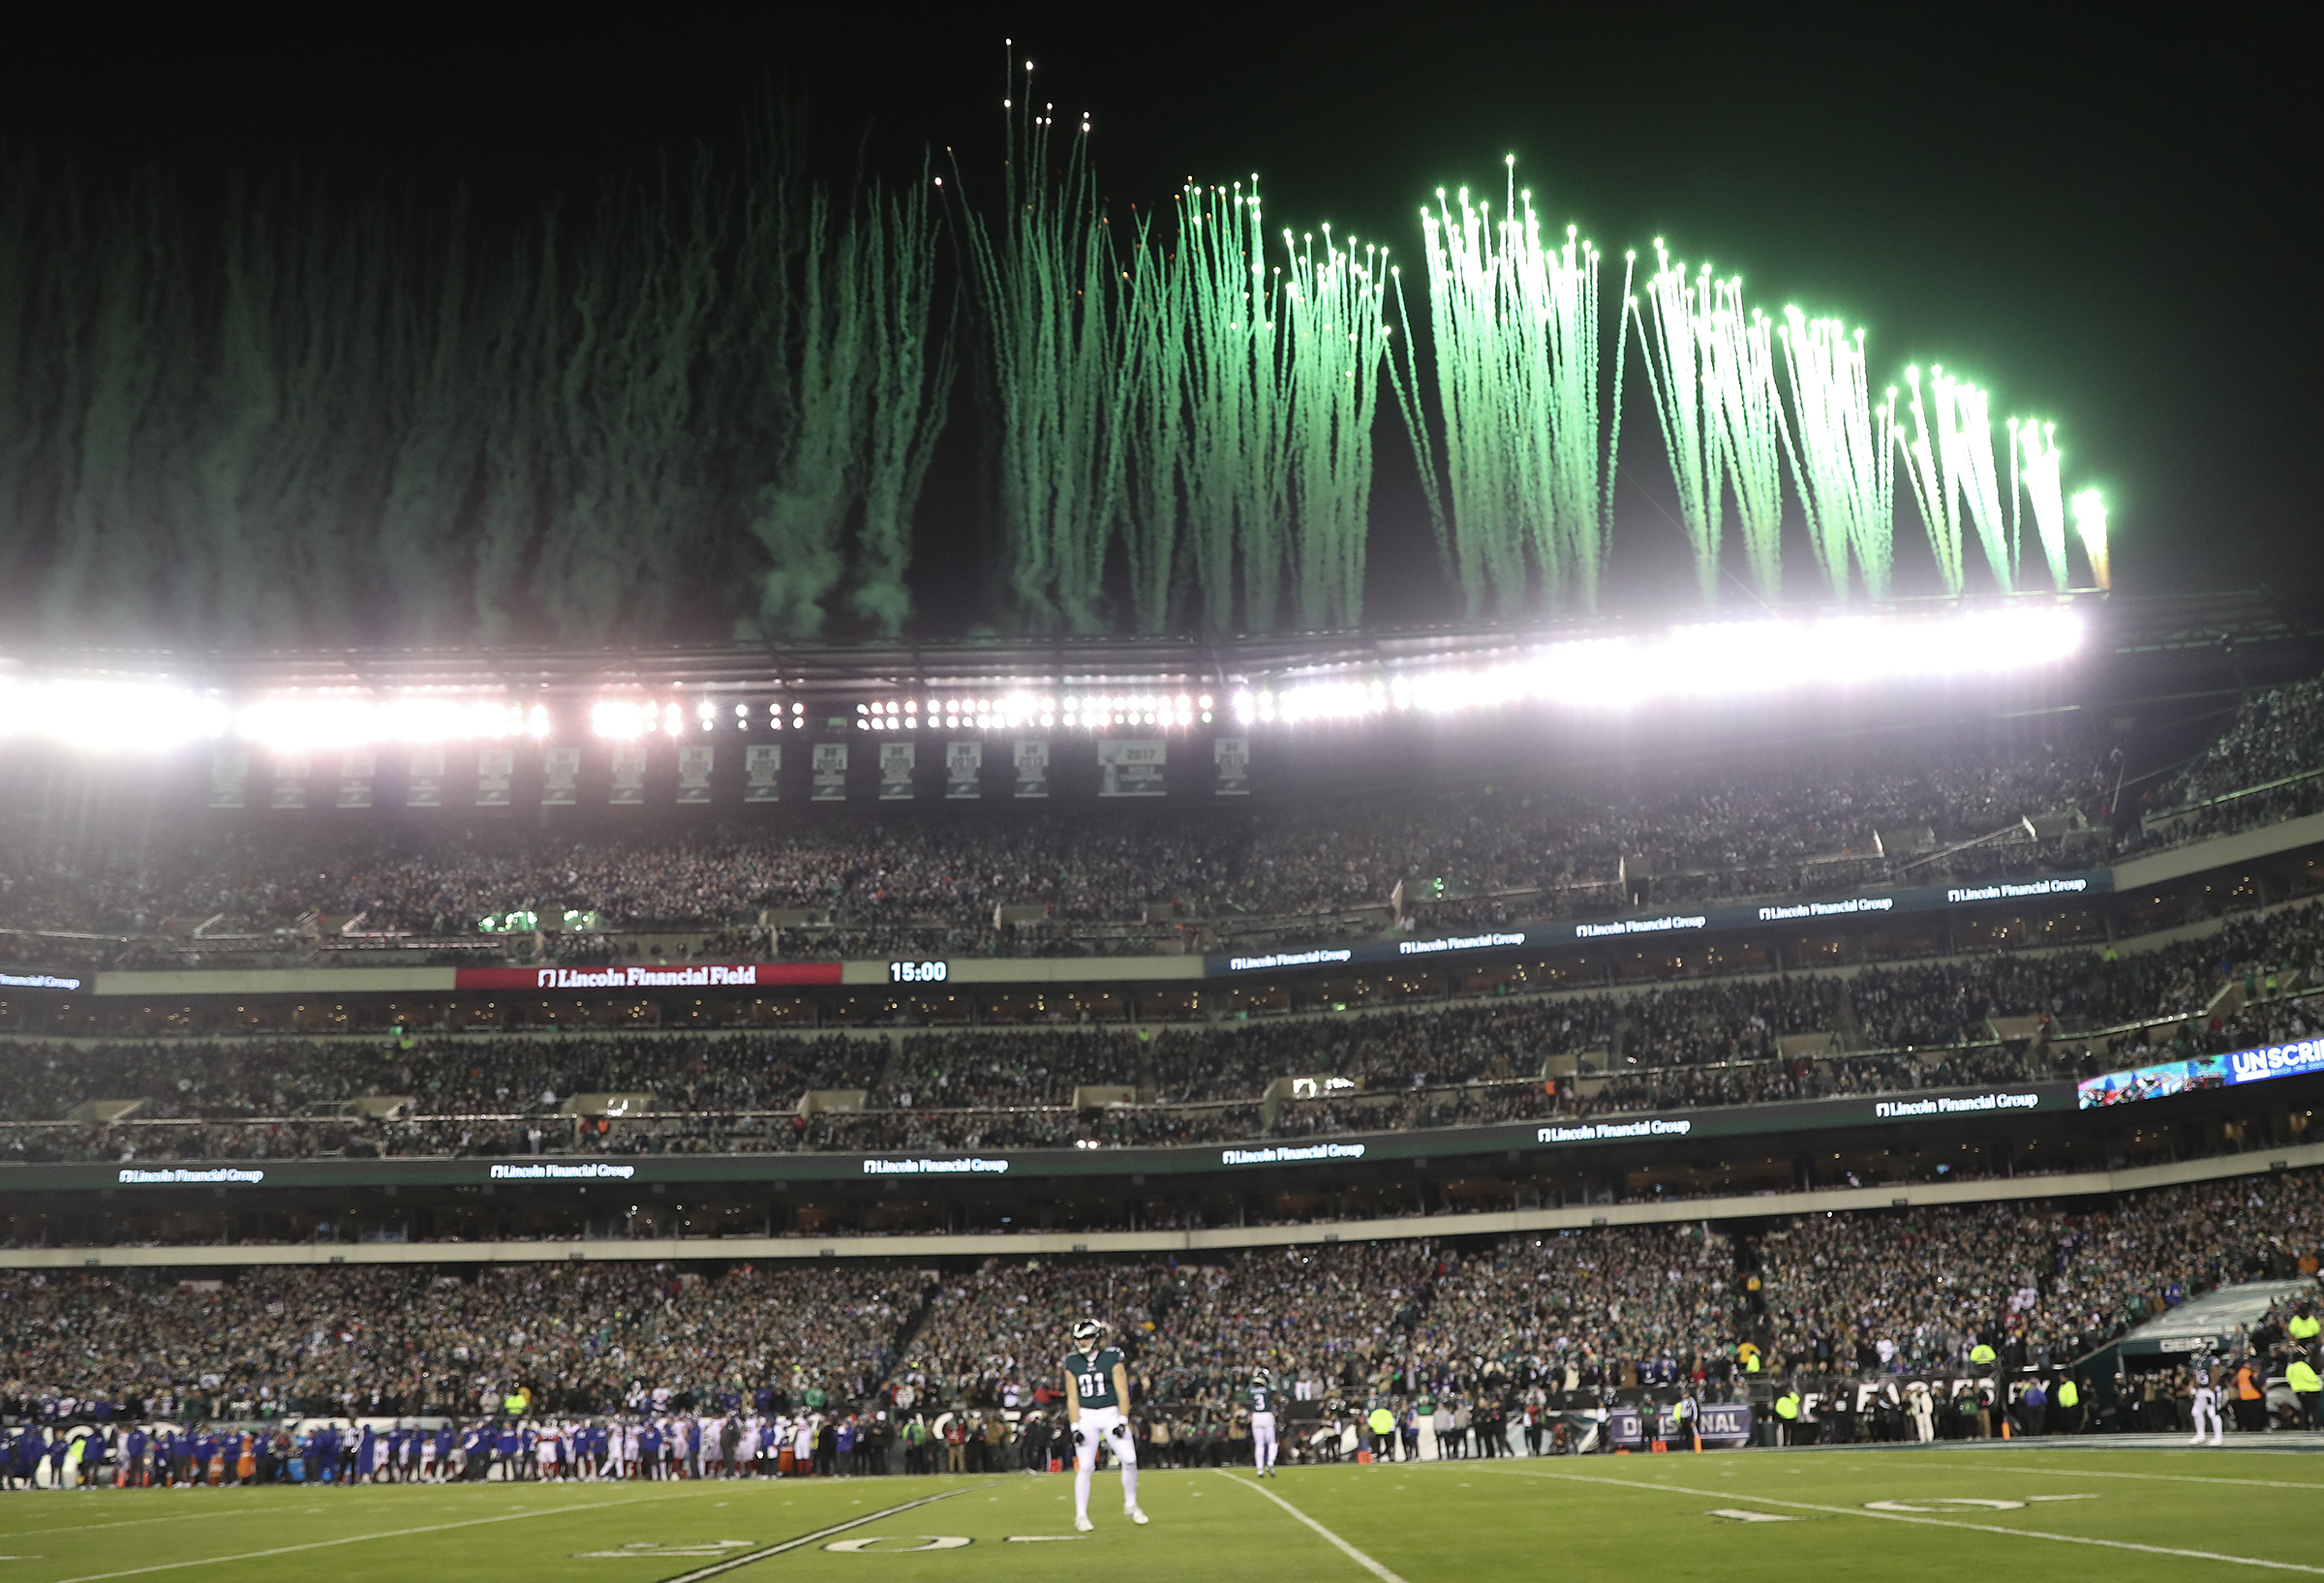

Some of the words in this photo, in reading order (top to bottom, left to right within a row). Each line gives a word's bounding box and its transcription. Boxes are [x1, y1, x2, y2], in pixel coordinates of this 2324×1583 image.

[1127, 749, 1155, 760] 2017
[1960, 886, 2001, 901] Lincoln
[2001, 880, 2050, 897] Financial
[2051, 879, 2087, 892] Group
[1771, 904, 1810, 919] Lincoln
[1810, 898, 1857, 915] Financial
[1858, 898, 1893, 910] Group
[1588, 922, 1626, 936] Lincoln
[1626, 917, 1671, 933] Financial
[1672, 916, 1706, 928] Group
[1412, 939, 1448, 954] Lincoln
[1448, 934, 1492, 949] Financial
[1492, 933, 1525, 945] Group
[1241, 956, 1276, 969] Lincoln
[1276, 951, 1319, 966] Financial
[1319, 950, 1351, 961] Group
[558, 968, 626, 987] Lincoln
[627, 966, 708, 986] Financial
[709, 965, 755, 985] Field
[890, 961, 946, 982] 15:00
[45, 976, 79, 989] Group
[1890, 1099, 1937, 1116] Lincoln
[1938, 1094, 1996, 1113] Financial
[1996, 1093, 2038, 1111] Group
[1551, 1125, 1595, 1142] Lincoln
[1596, 1120, 1650, 1138] Financial
[1651, 1120, 1691, 1135] Group
[1236, 1148, 1276, 1164] Lincoln
[1276, 1144, 1328, 1161] Financial
[1328, 1143, 1365, 1158] Group
[504, 1165, 545, 1178] Lincoln
[545, 1164, 596, 1177] Financial
[597, 1164, 634, 1179] Group
[876, 1159, 919, 1172] Lincoln
[919, 1158, 970, 1172] Financial
[971, 1158, 1009, 1173] Group
[133, 1169, 174, 1182] Lincoln
[174, 1169, 227, 1182] Financial
[227, 1169, 263, 1183] Group
[1254, 1394, 1265, 1411] 3
